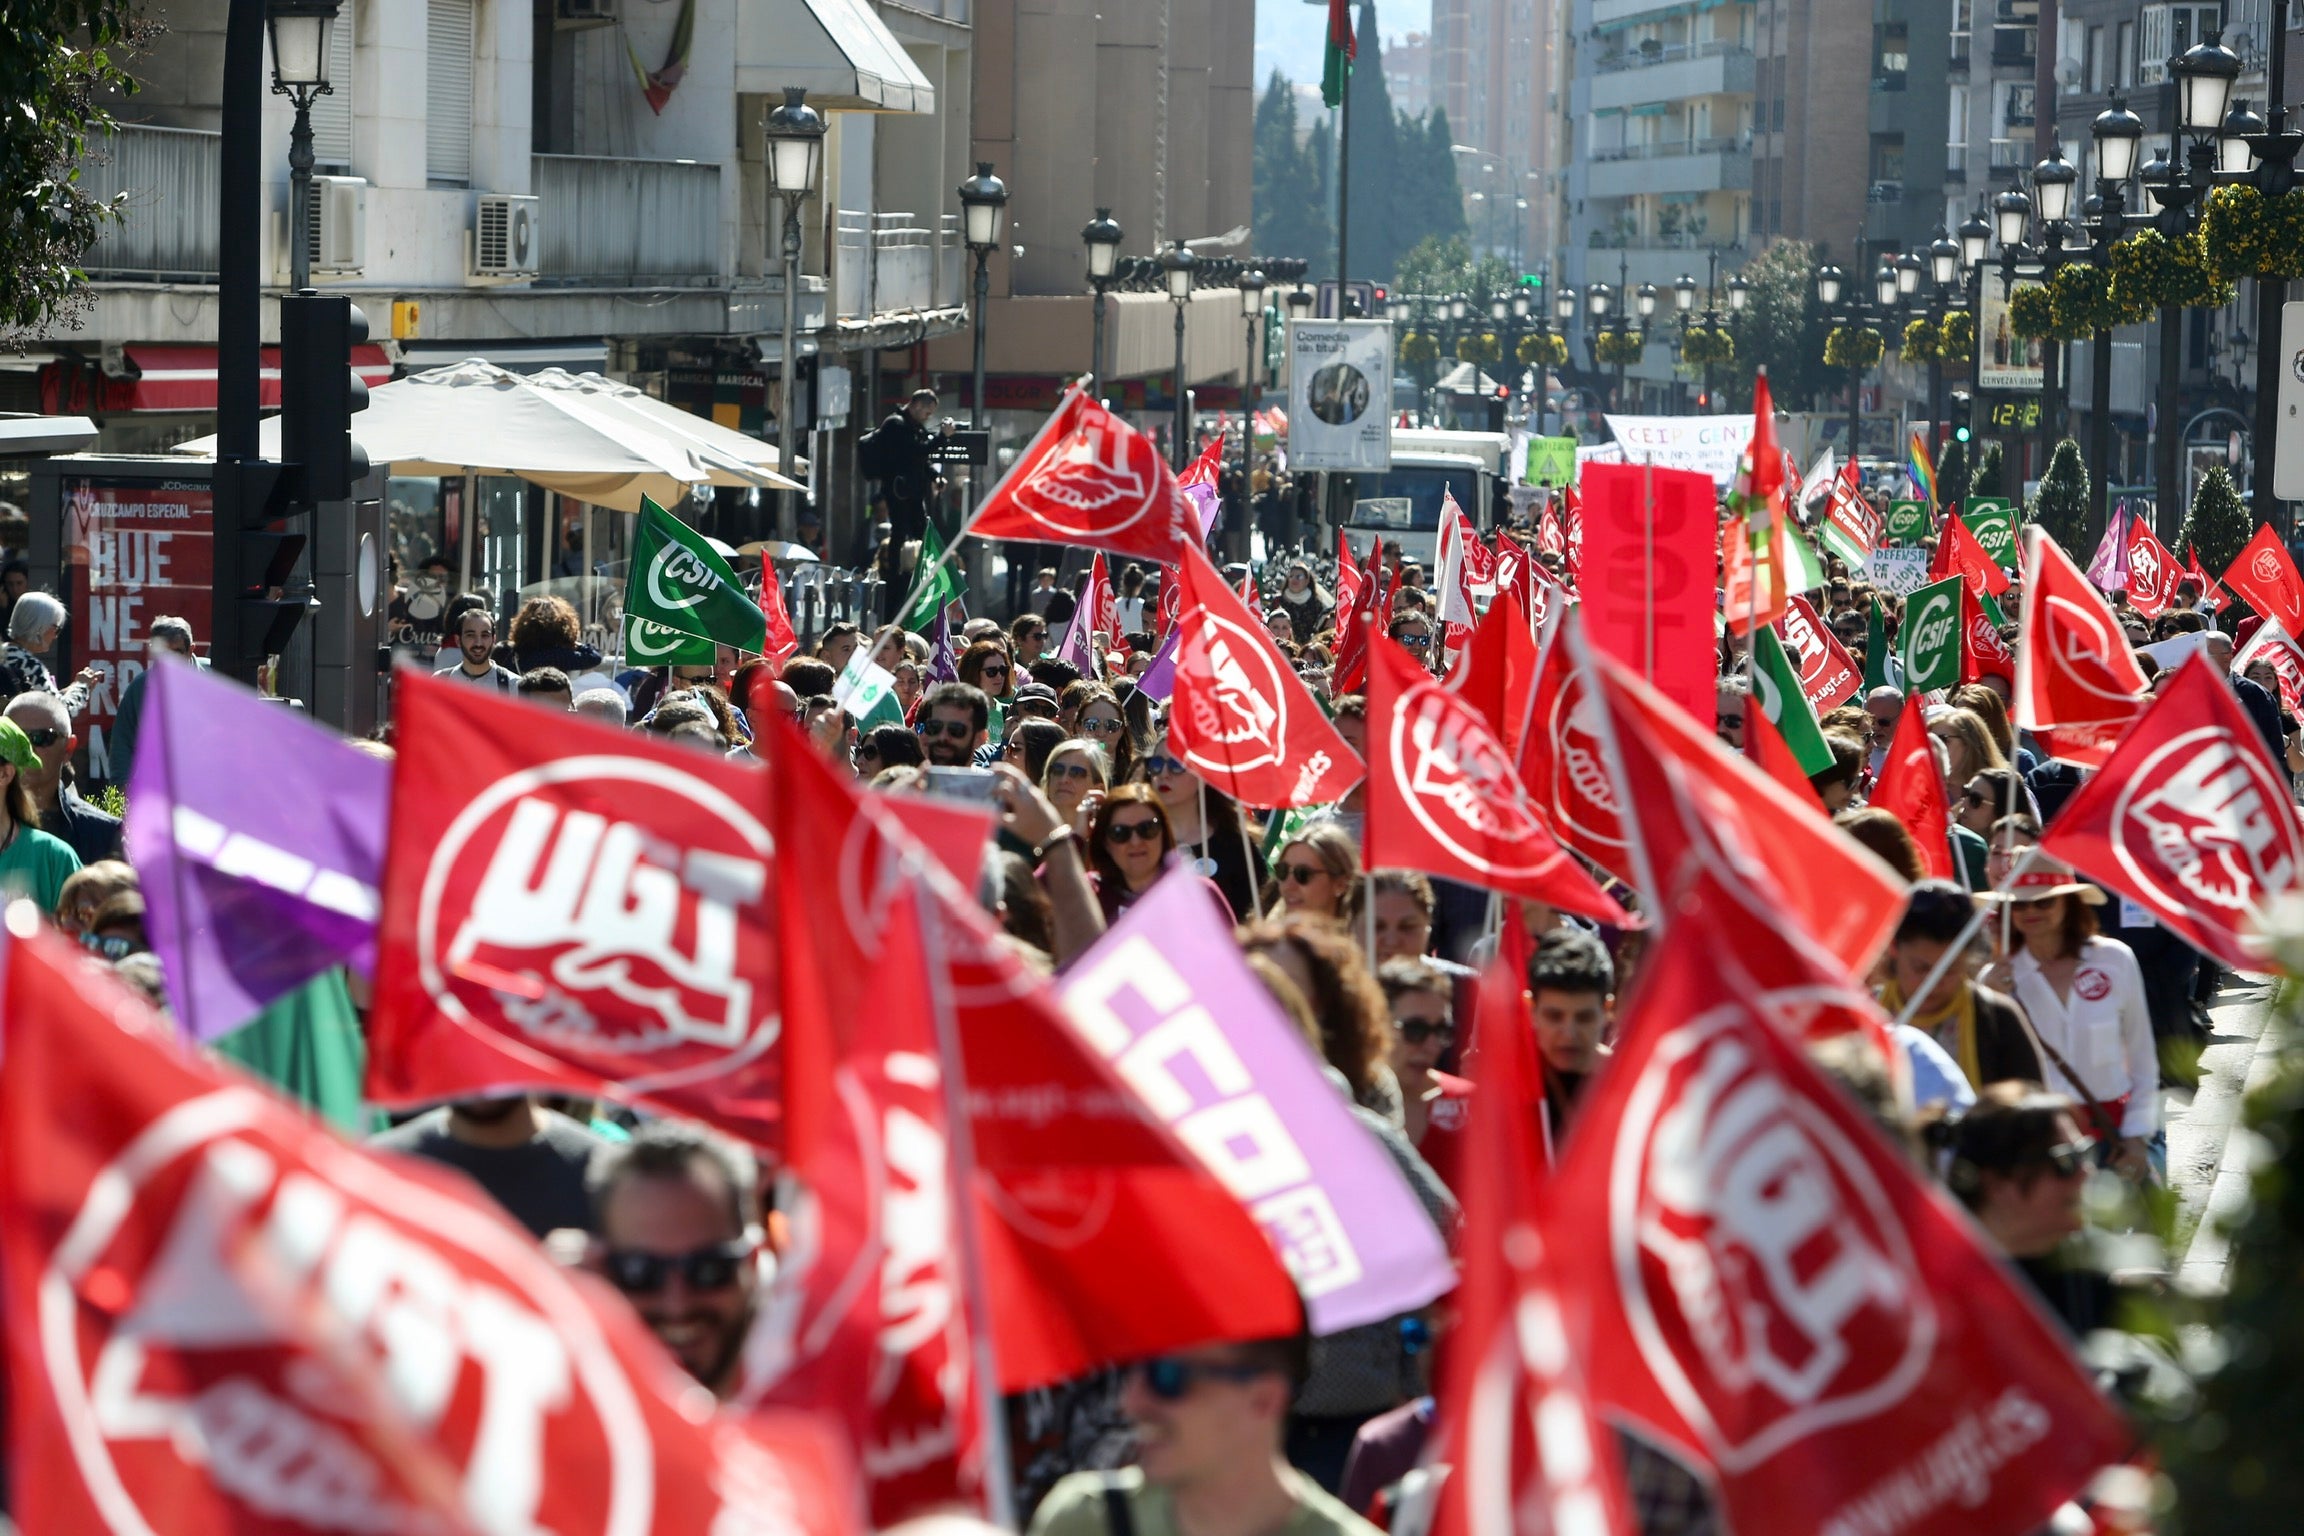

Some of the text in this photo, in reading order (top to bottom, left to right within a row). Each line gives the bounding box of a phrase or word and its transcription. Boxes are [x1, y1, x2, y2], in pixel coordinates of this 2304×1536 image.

[1296, 331, 1349, 342] Comedia
[716, 374, 764, 387] MARISCAL
[1628, 427, 1683, 445] CEIP
[160, 481, 211, 491] JCDecaux
[89, 503, 191, 519] CRUZCAMPO ESPECIAL
[1977, 529, 2014, 549] CSIF
[89, 531, 173, 588] BUE
[89, 585, 144, 651] NÉ
[1916, 616, 1953, 655] CSIF
[468, 796, 768, 988] UGT
